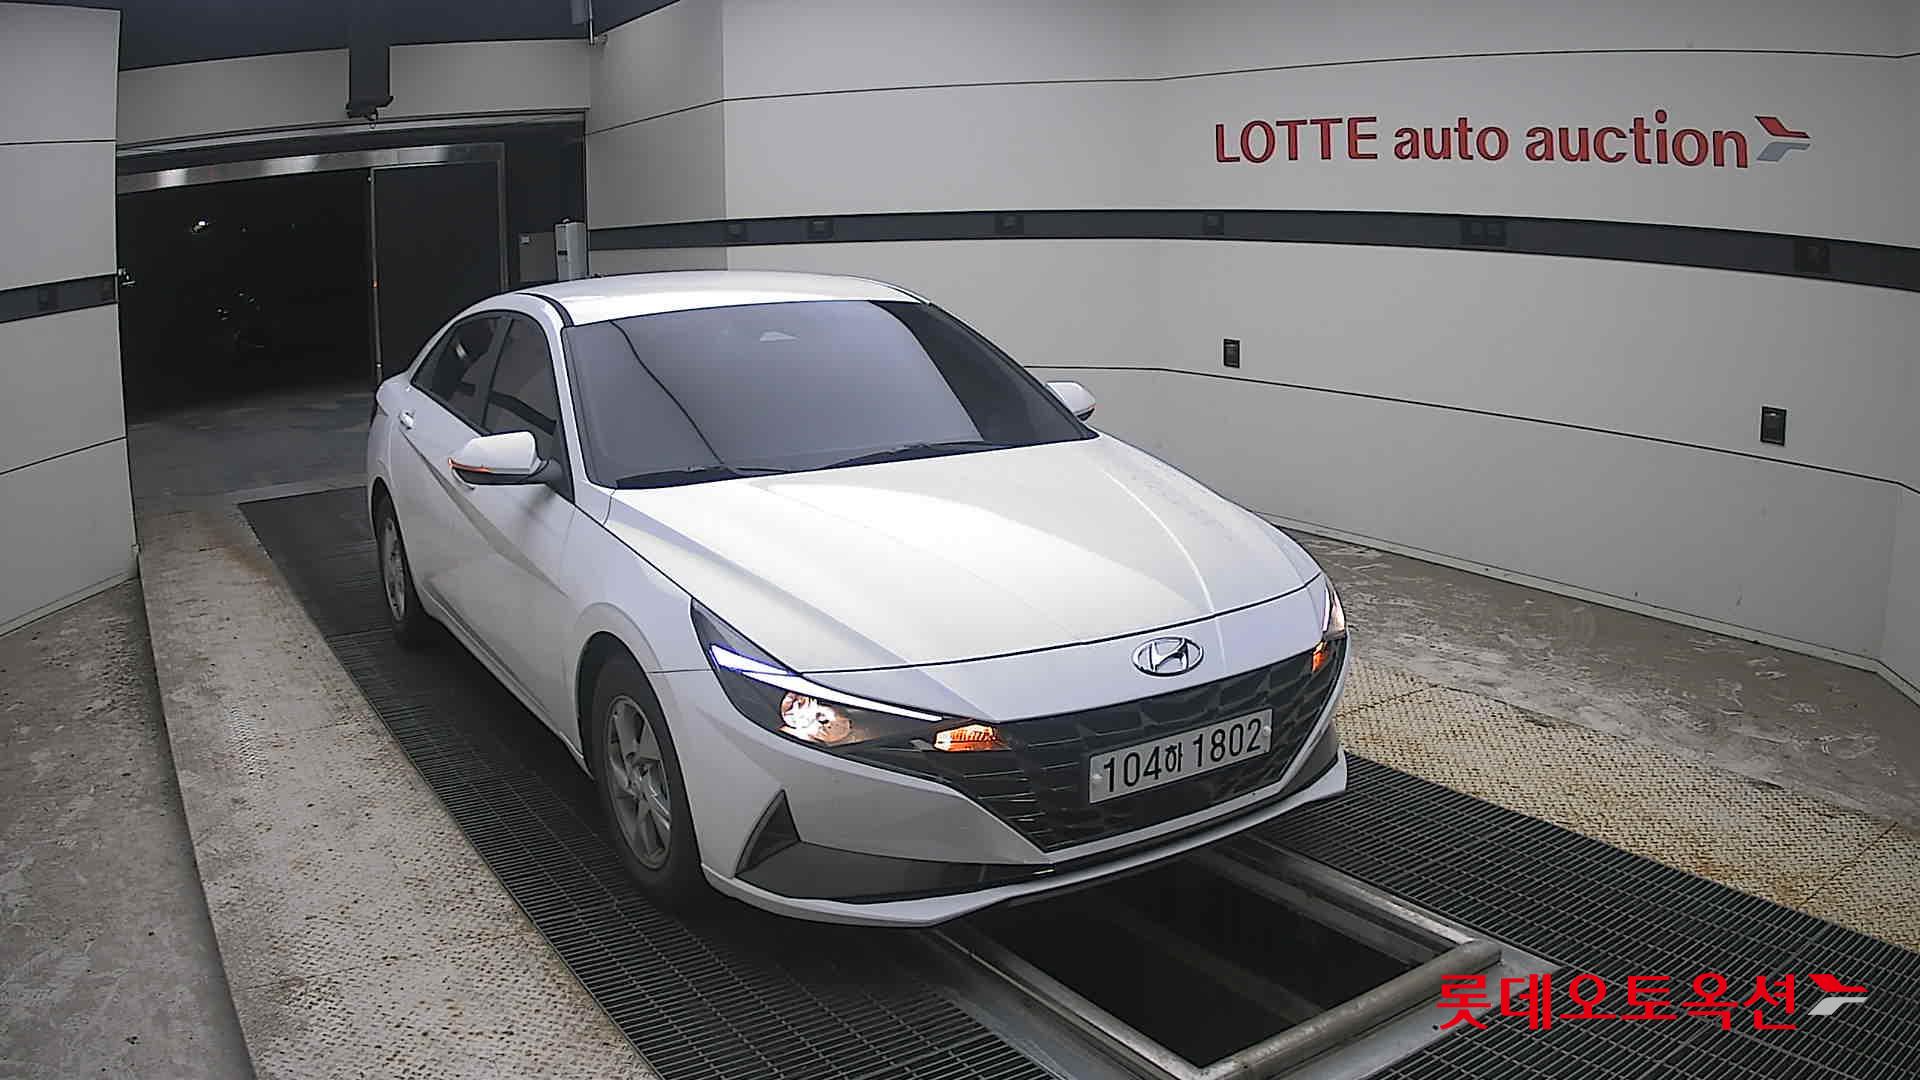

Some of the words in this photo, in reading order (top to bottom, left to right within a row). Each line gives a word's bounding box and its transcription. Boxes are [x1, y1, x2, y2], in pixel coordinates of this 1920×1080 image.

[1214, 117, 1379, 164] LOTTE
[1393, 116, 1510, 162] auto
[1525, 109, 1750, 169] auction
[1102, 741, 1184, 793] 104하
[1192, 717, 1263, 768] 1802
